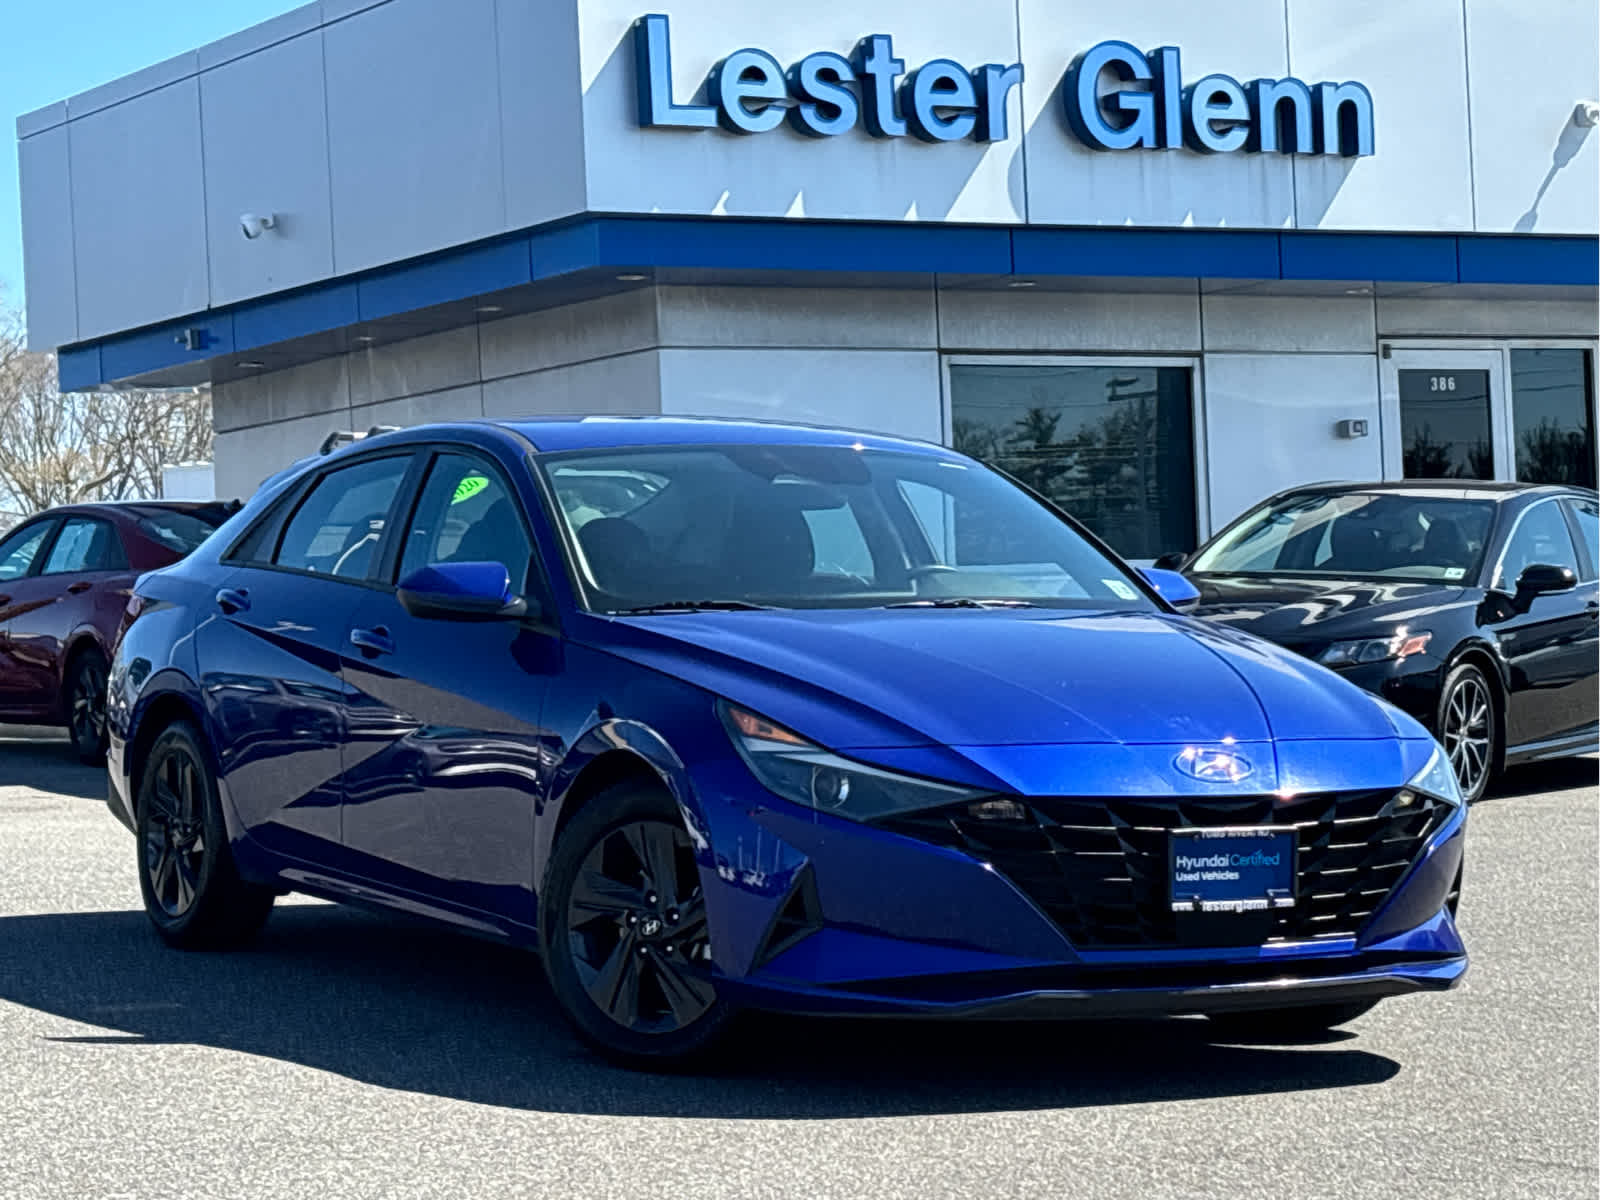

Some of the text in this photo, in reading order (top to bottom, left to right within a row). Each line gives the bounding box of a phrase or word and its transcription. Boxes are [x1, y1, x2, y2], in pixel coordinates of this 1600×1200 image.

[637, 13, 1375, 156] Lester Glenn
[1430, 376, 1456, 392] 386
[1175, 850, 1280, 870] Hyundai Certified
[1175, 870, 1240, 881] Used Vehicles
